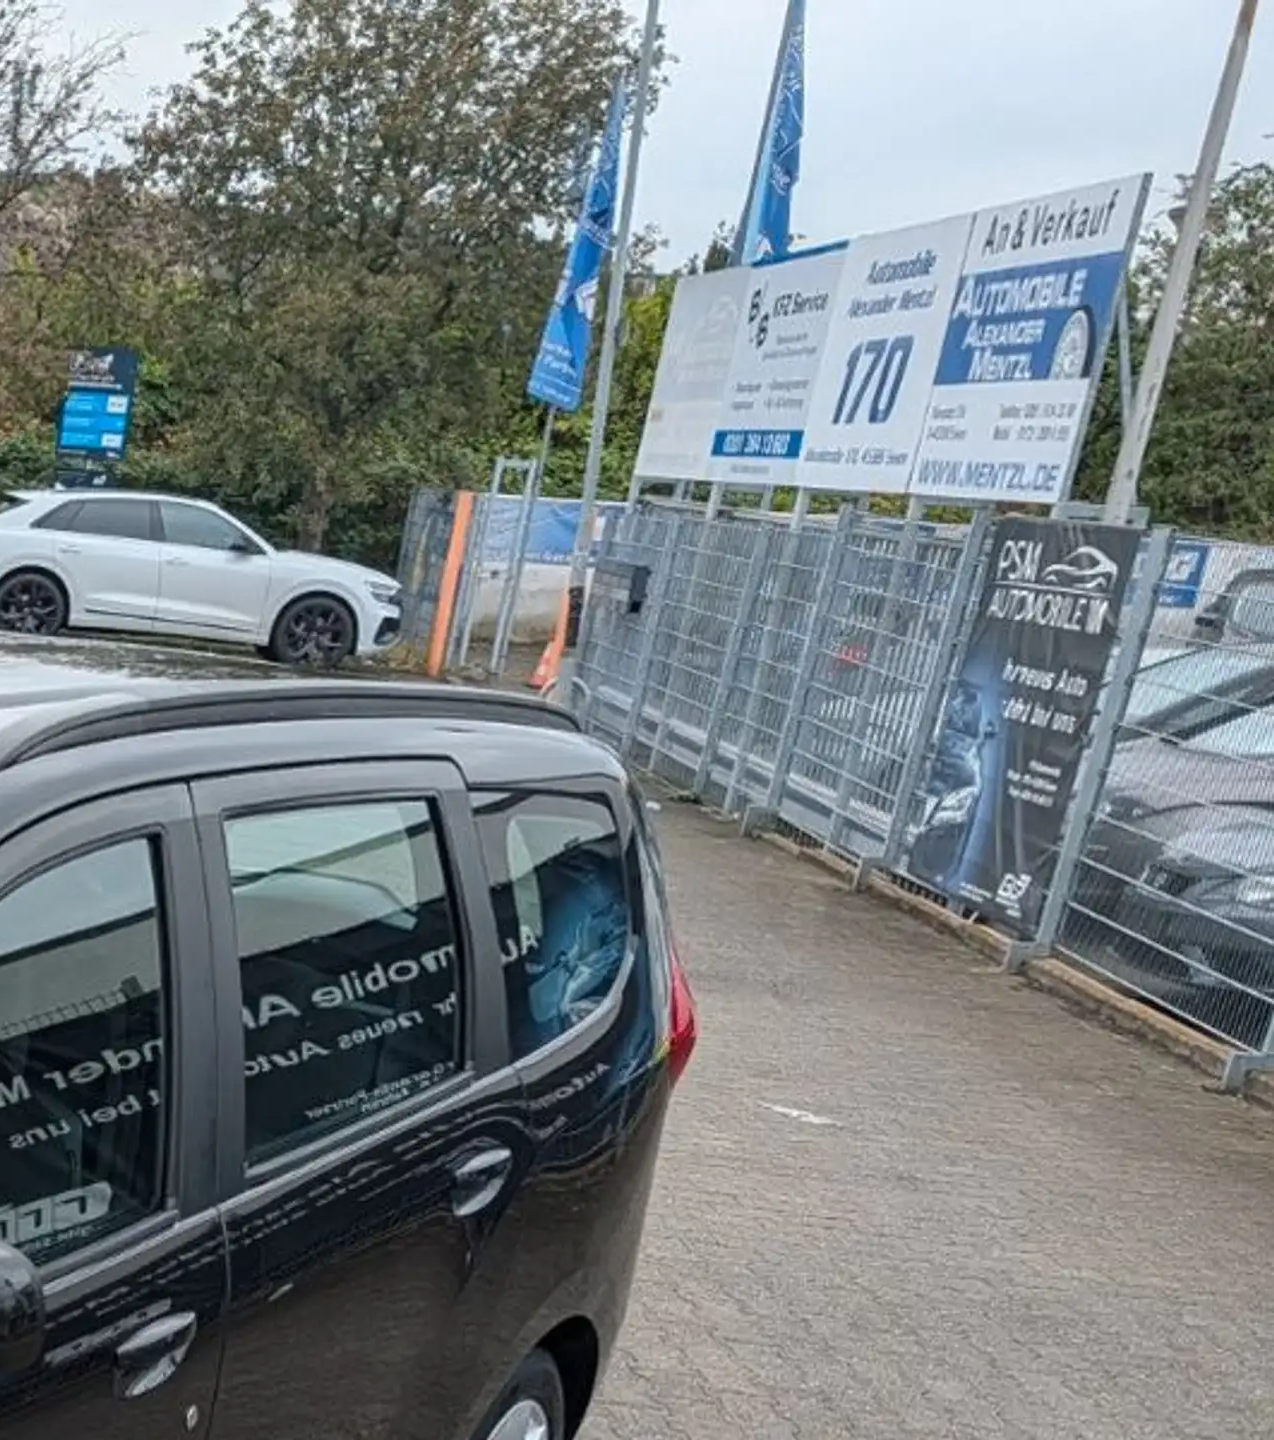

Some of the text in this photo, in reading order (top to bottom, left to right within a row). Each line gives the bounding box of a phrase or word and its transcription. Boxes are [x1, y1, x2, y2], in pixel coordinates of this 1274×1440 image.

[982, 214, 1007, 256] An
[1030, 187, 1120, 247] Verkauf
[792, 290, 829, 314] Service
[953, 268, 1089, 320] AUTOMOBILE
[831, 334, 915, 425] 170
[917, 458, 1061, 492] WWW.MENTZL.DE
[997, 540, 1043, 582] PSM
[1055, 667, 1089, 697] Auto
